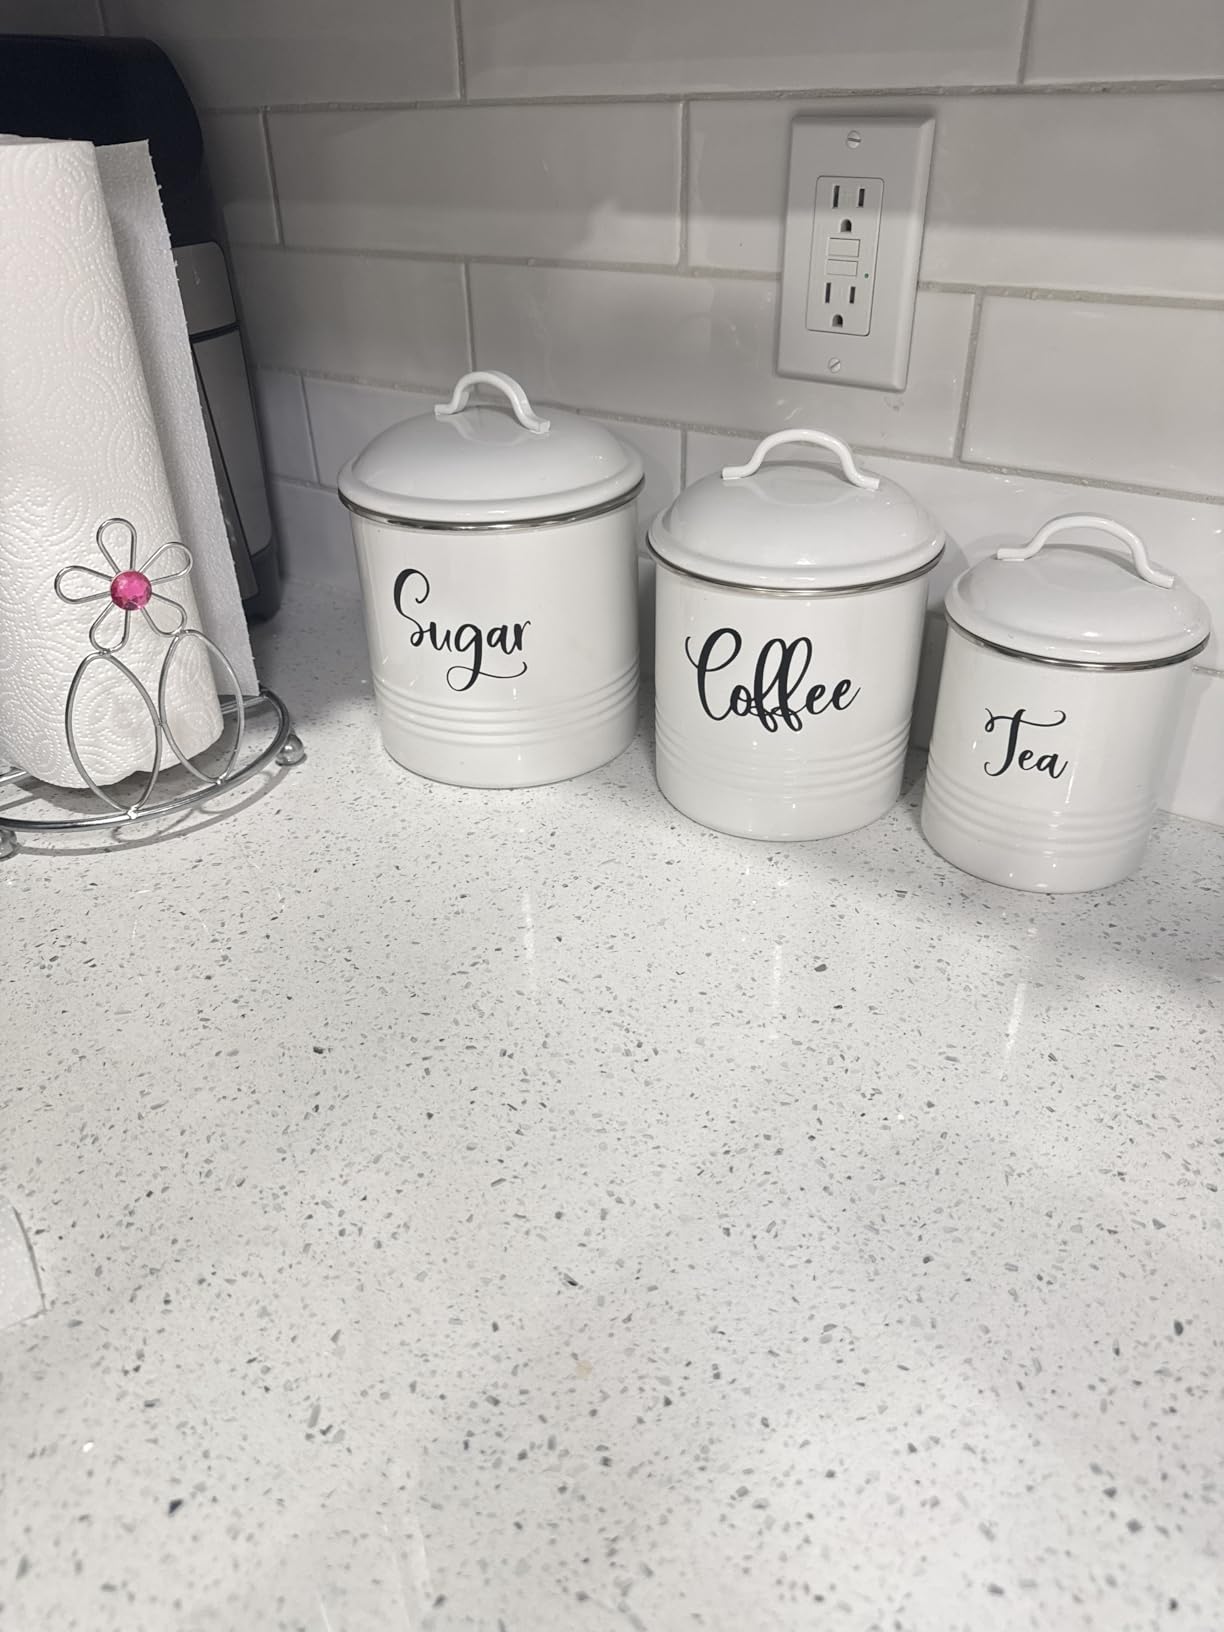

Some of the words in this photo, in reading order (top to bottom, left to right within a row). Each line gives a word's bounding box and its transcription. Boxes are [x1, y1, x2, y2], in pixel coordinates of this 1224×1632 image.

[393, 568, 531, 692] Sugar
[684, 627, 861, 733] Coffee
[983, 708, 1069, 780] Tea
